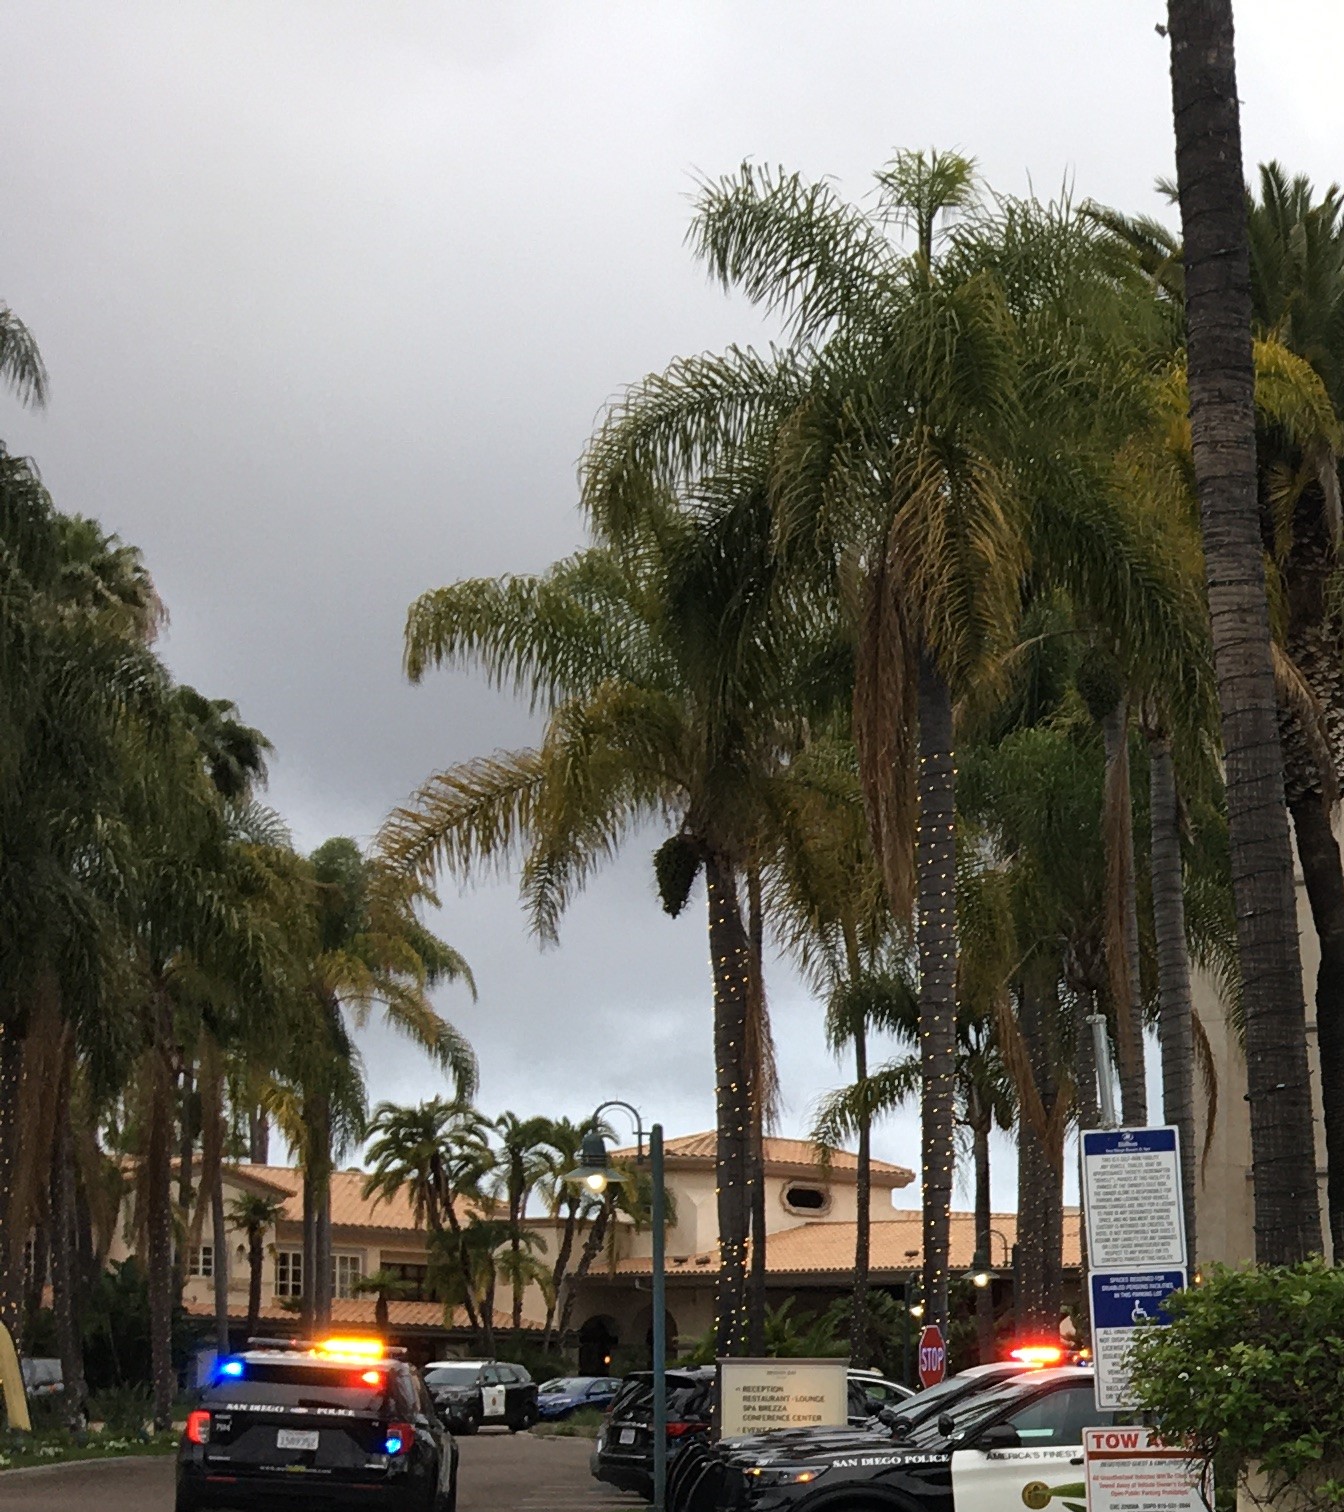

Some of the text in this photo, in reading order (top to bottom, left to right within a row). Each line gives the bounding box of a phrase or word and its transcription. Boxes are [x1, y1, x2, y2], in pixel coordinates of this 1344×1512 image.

[921, 1347, 943, 1371] STOP
[249, 1404, 284, 1413] DIEGO
[316, 1407, 355, 1416] POLICE
[1092, 1433, 1139, 1449] TOW
[832, 1454, 950, 1468] SAN DIEGO POLICE
[986, 1450, 1077, 1460] AMERICA'S FINEST
